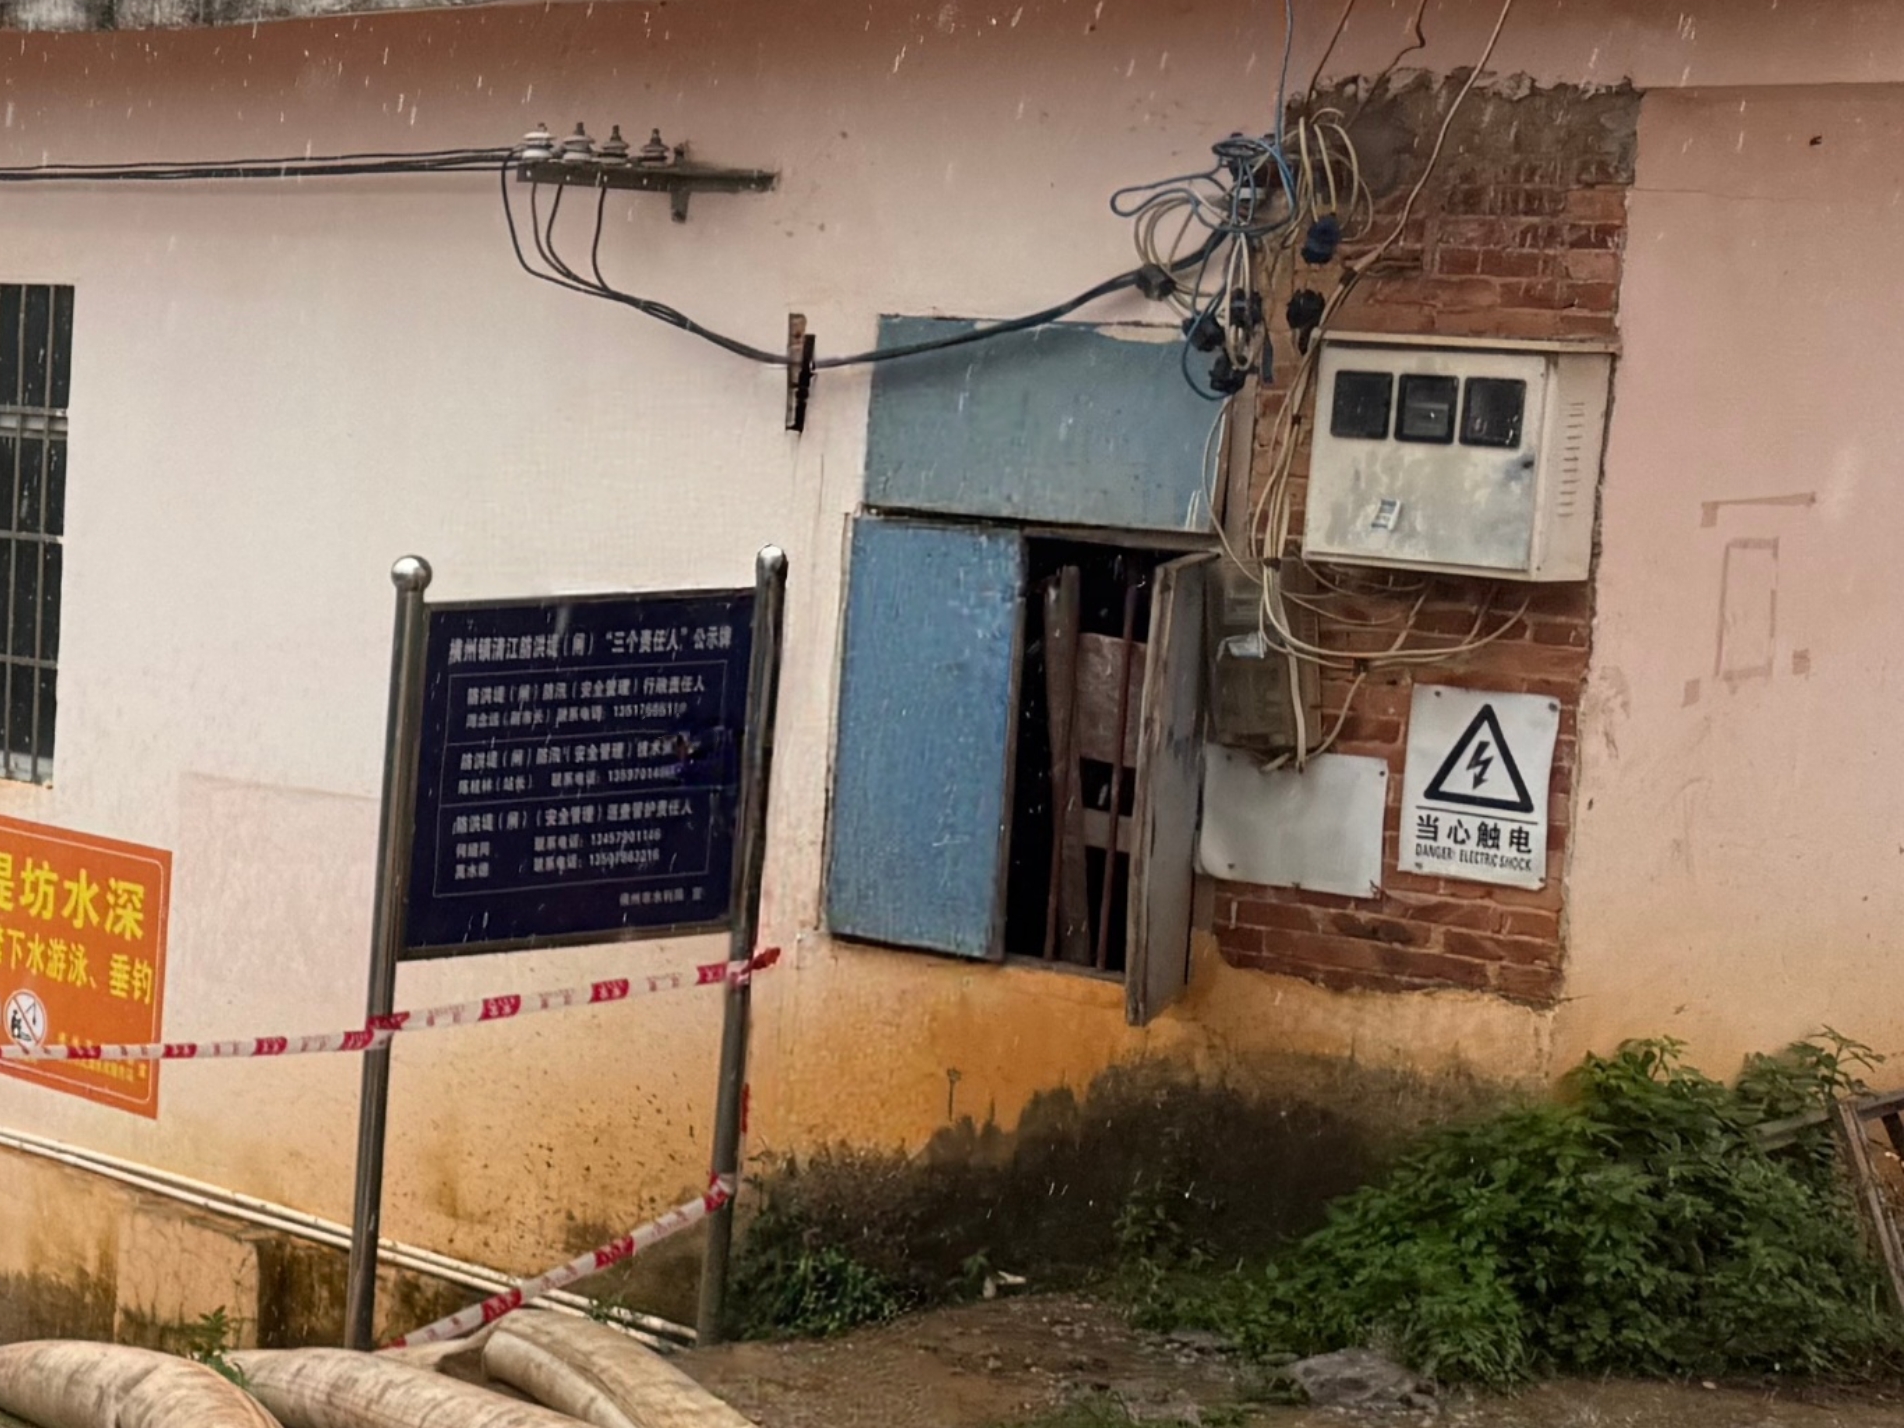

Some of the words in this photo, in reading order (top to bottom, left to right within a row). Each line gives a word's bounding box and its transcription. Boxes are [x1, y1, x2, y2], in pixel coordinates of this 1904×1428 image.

[1415, 814, 1532, 854] 当心触电
[1459, 849, 1499, 868] ELECTRIC
[1499, 855, 1532, 872] SHOCK
